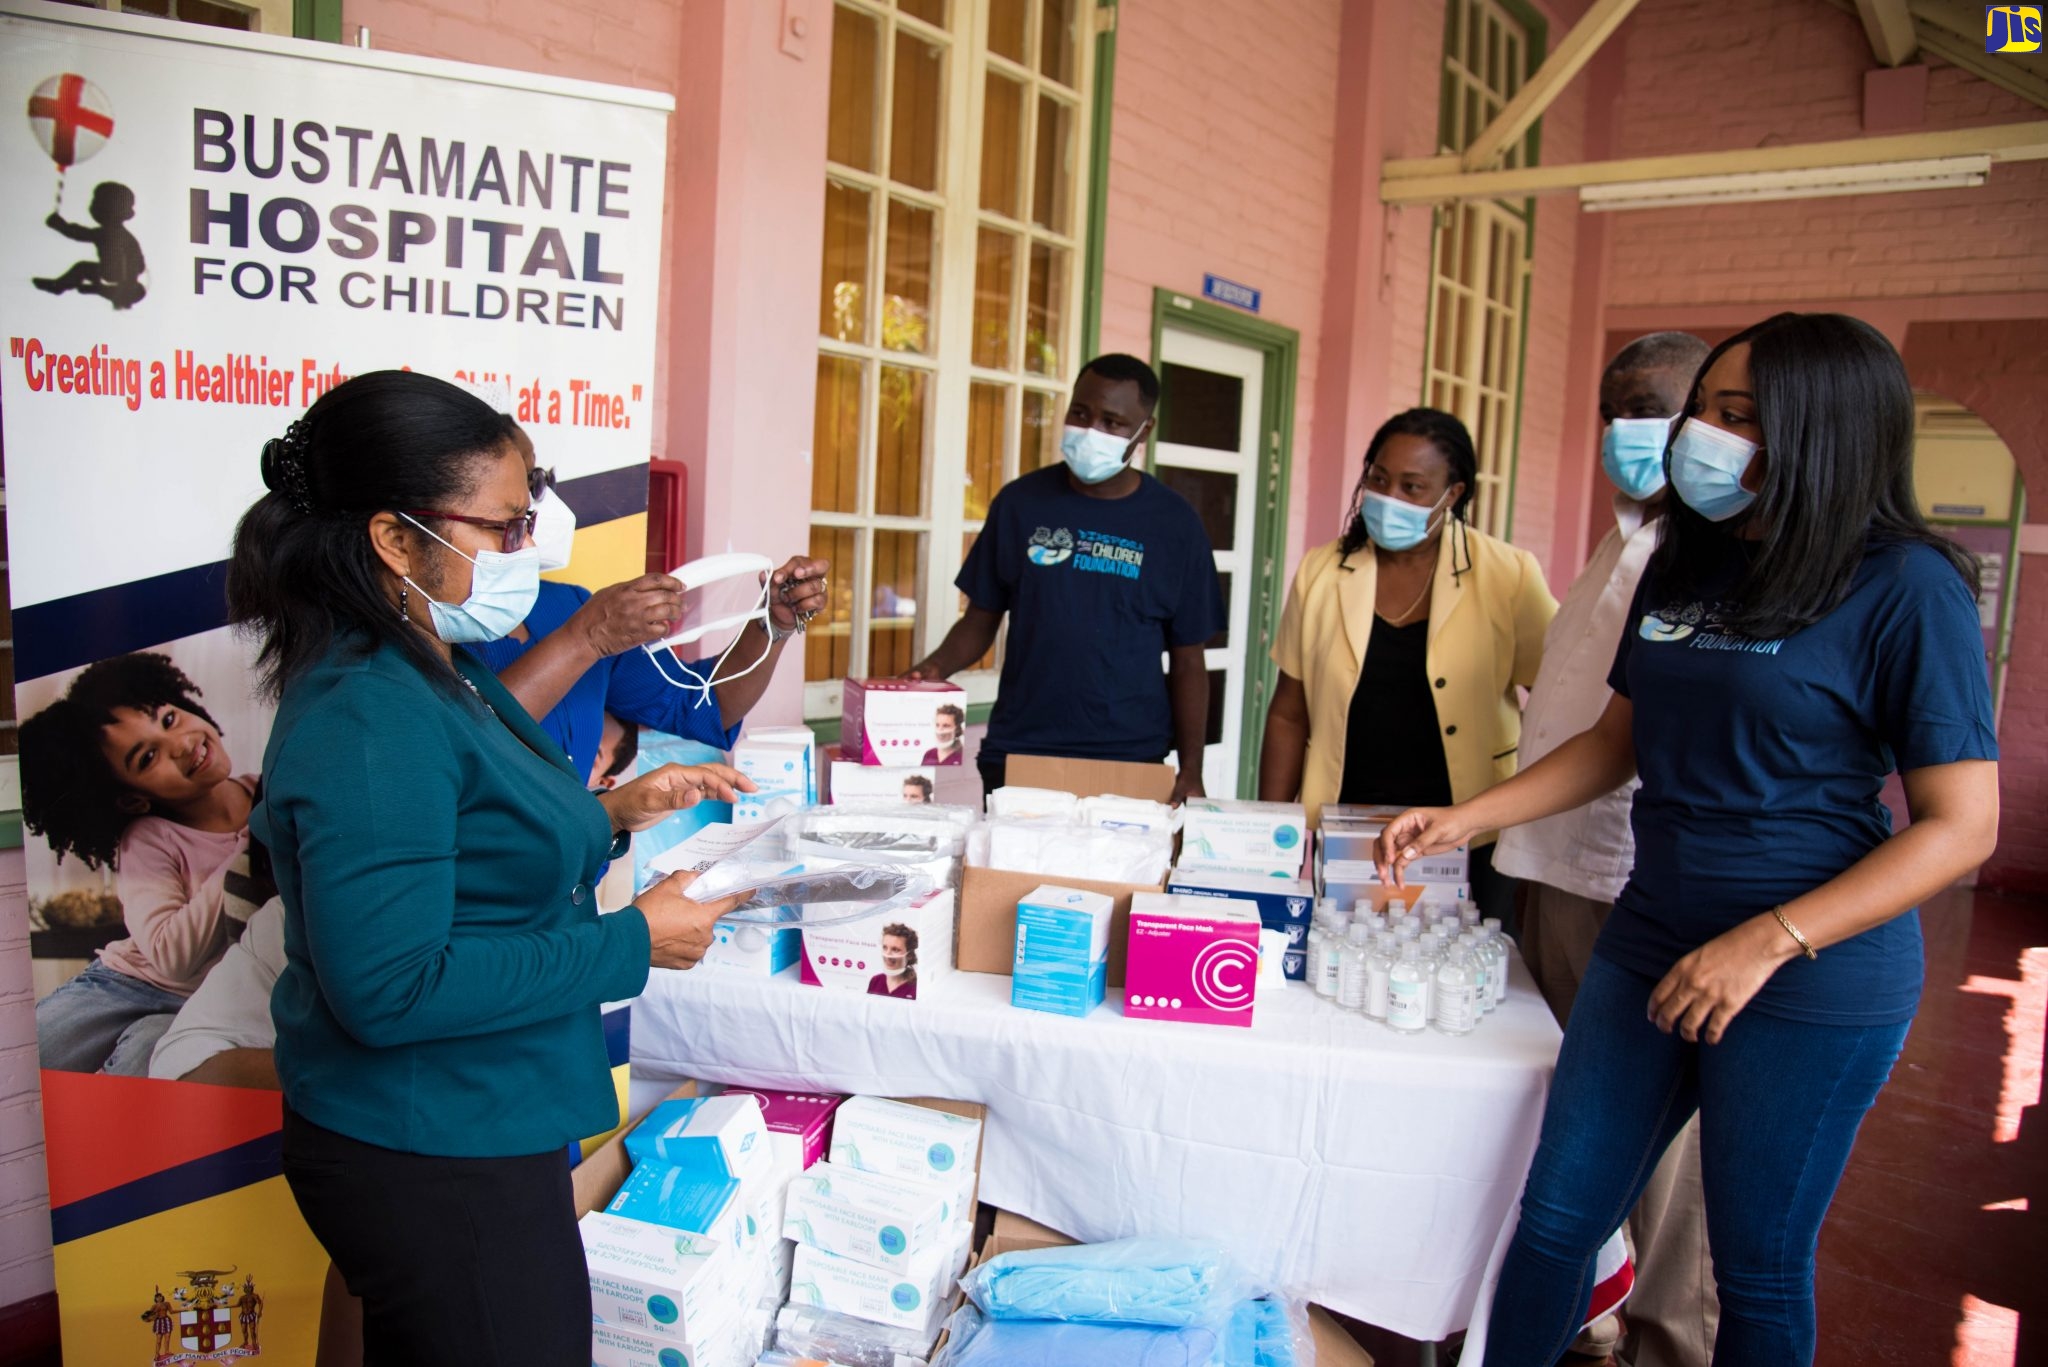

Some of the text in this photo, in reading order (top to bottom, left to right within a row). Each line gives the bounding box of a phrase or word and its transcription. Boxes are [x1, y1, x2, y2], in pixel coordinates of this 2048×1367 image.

[193, 107, 632, 219] BUSTAMANTE
[189, 188, 624, 285] HOSPITAL
[194, 257, 624, 331] FOR CHILDREN
[10, 337, 141, 411] "Creating
[150, 360, 166, 399] a
[175, 349, 295, 407] Healthier
[518, 377, 540, 423] at
[547, 387, 561, 425] a
[569, 379, 643, 429] Time."
[1091, 542, 1144, 567] CHILDREN
[1073, 554, 1140, 579] FOUNDATION
[1173, 887, 1193, 895] RHINO
[1136, 920, 1214, 933] Transparent Face Mask
[602, 1280, 644, 1295] FACE MASK
[605, 1289, 645, 1304] EARLOOPS
[653, 1324, 664, 1332] 50
[597, 1337, 656, 1356] WITH EARLOOPS
[613, 1333, 654, 1348] FACE MASK
[212, 1350, 228, 1359] ONE
